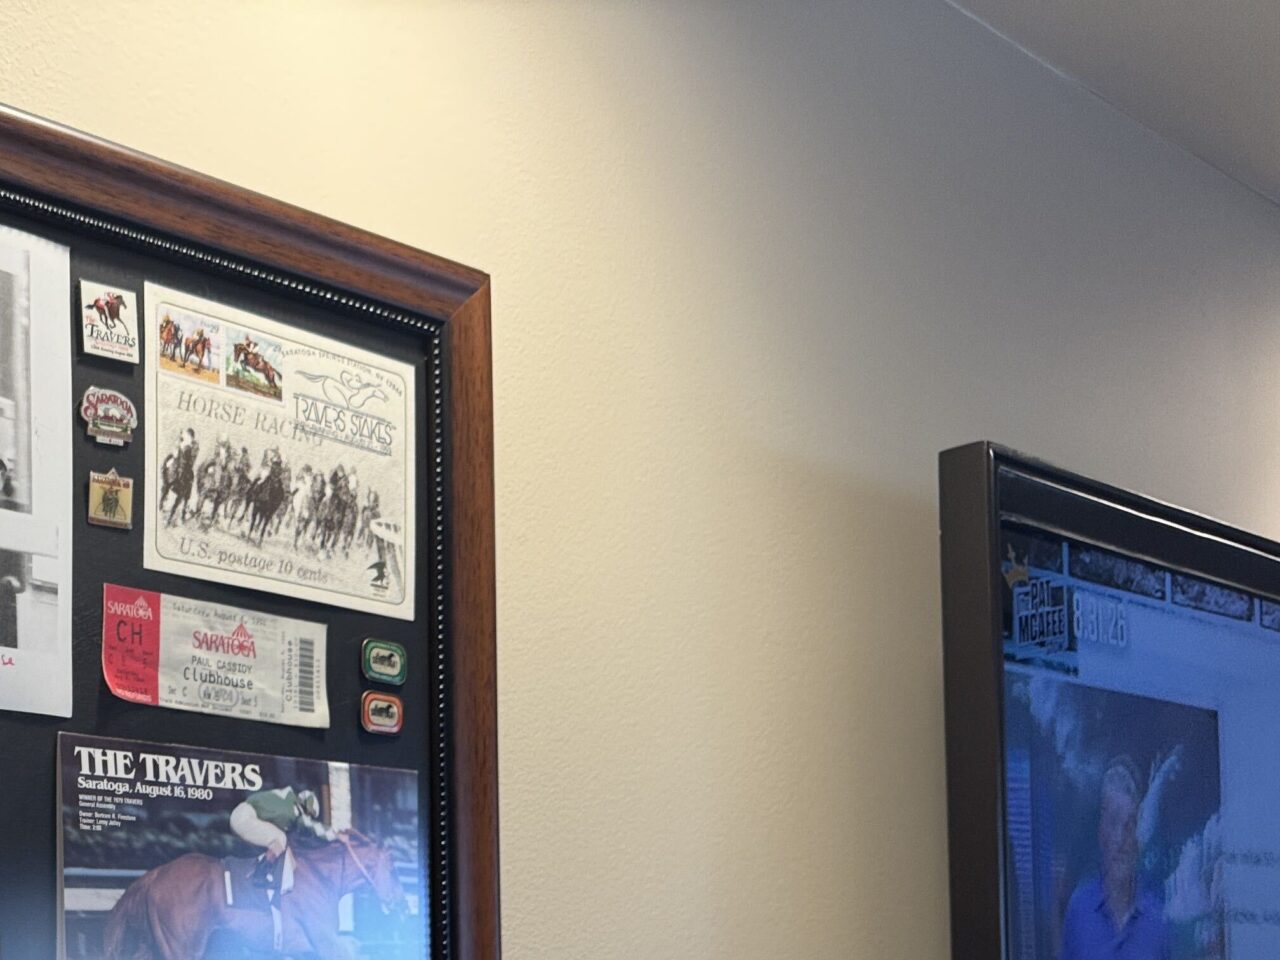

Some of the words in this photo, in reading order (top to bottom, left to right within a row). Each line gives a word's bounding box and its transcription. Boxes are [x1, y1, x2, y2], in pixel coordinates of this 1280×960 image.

[85, 323, 136, 348] TRAVERS
[177, 391, 246, 426] HORSE
[179, 537, 211, 559] U.S.
[218, 548, 273, 572] postage
[278, 559, 293, 573] 10
[1031, 580, 1051, 611] PAT
[108, 601, 152, 620] SARATOGA
[192, 630, 256, 659] SARATOGA
[192, 655, 212, 667] PAUL
[183, 667, 253, 690] Clubhouse
[74, 746, 136, 779] THE
[139, 753, 263, 792] TRAVERS
[77, 776, 133, 794] Saratoga,
[135, 782, 172, 798] August
[173, 787, 186, 799] 16,
[187, 787, 213, 800] 1980
